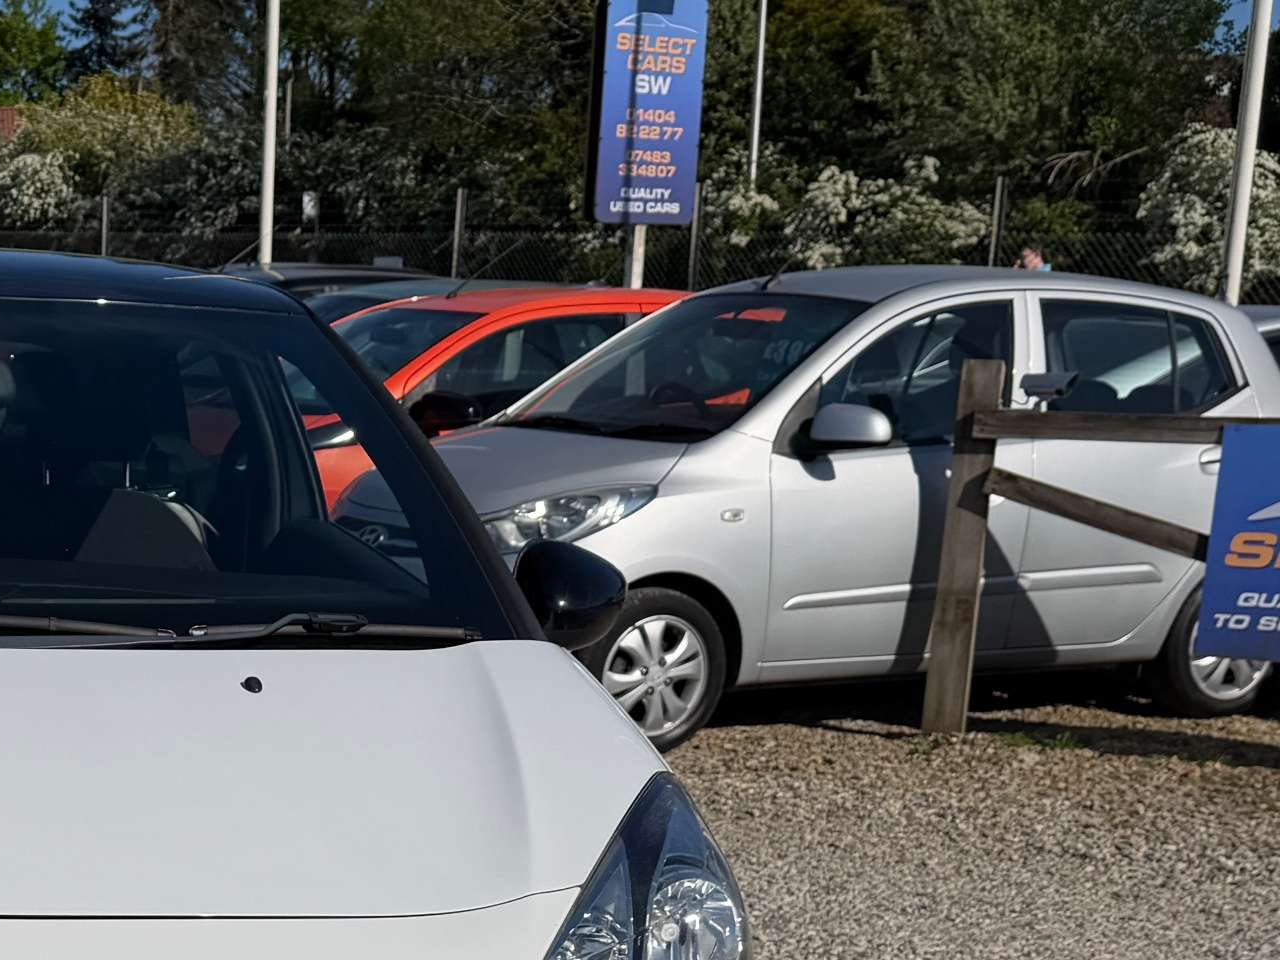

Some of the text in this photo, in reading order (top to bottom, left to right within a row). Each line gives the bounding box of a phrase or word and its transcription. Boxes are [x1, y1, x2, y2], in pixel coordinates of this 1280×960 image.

[616, 32, 697, 55] SELECT
[627, 53, 687, 74] CARS
[635, 74, 672, 95] SW
[620, 187, 672, 200] QUALITY
[645, 201, 680, 214] CARS
[1224, 531, 1280, 568] S
[1237, 592, 1280, 609] QU
[1213, 613, 1280, 631] TO S
